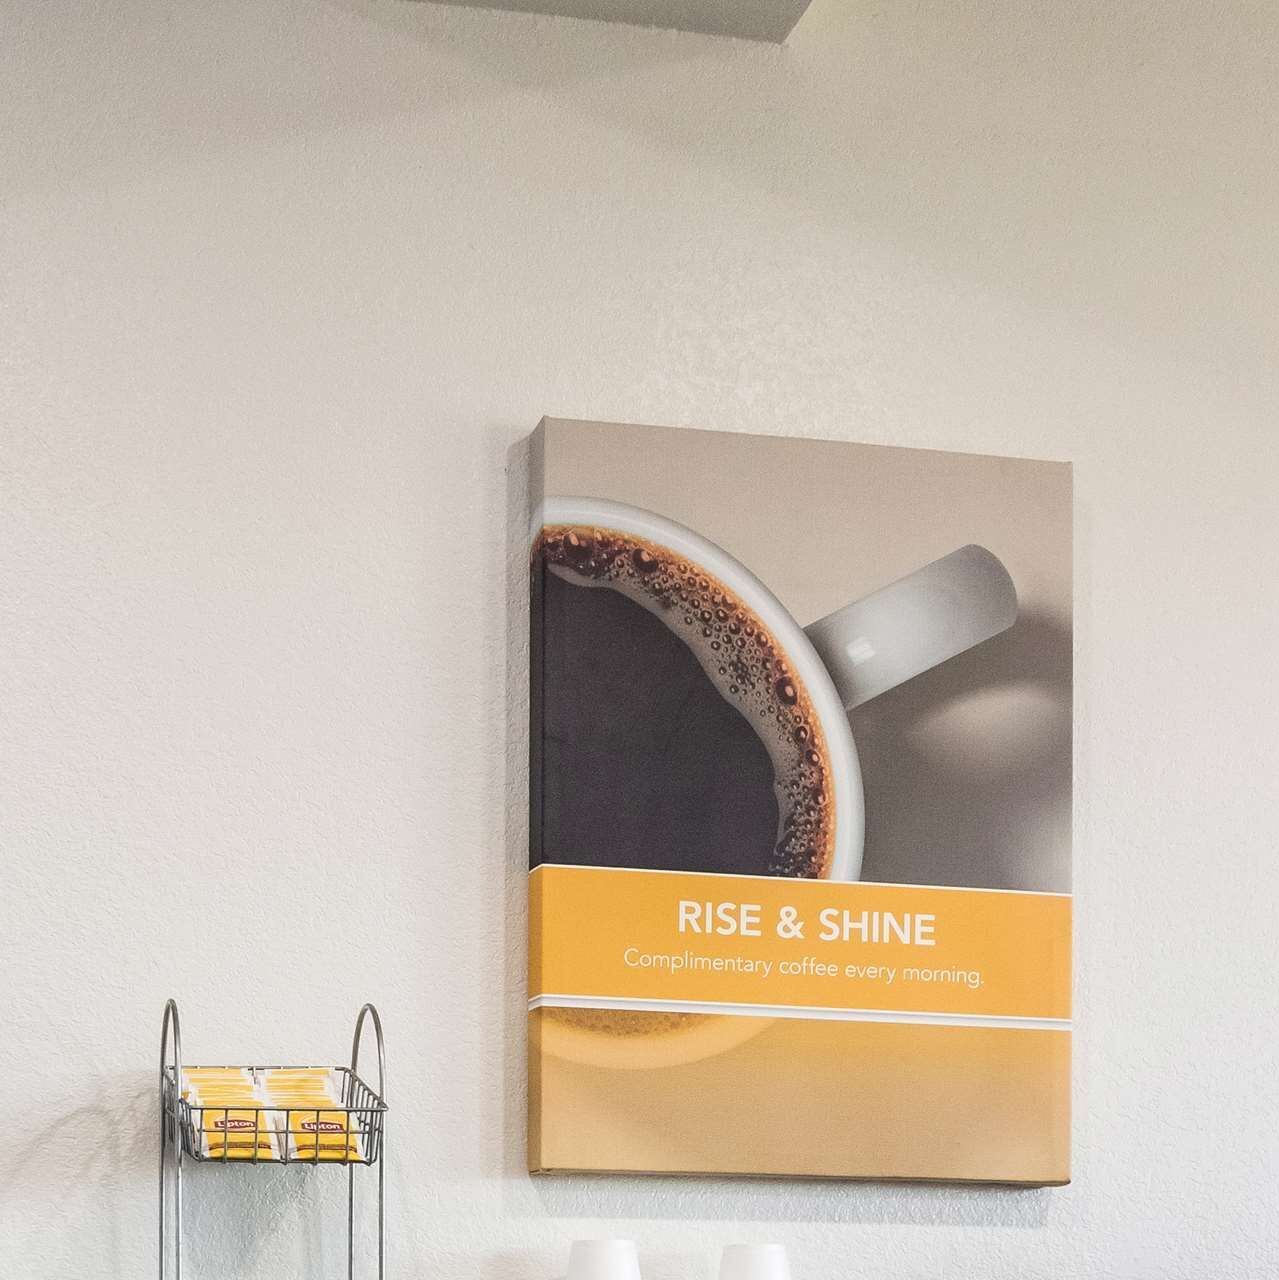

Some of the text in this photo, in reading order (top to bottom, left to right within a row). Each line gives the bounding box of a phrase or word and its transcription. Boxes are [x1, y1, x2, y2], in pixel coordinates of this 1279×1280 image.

[677, 900, 937, 946] RISE & SHINE
[623, 947, 985, 988] Complimentary coffee every morning.
